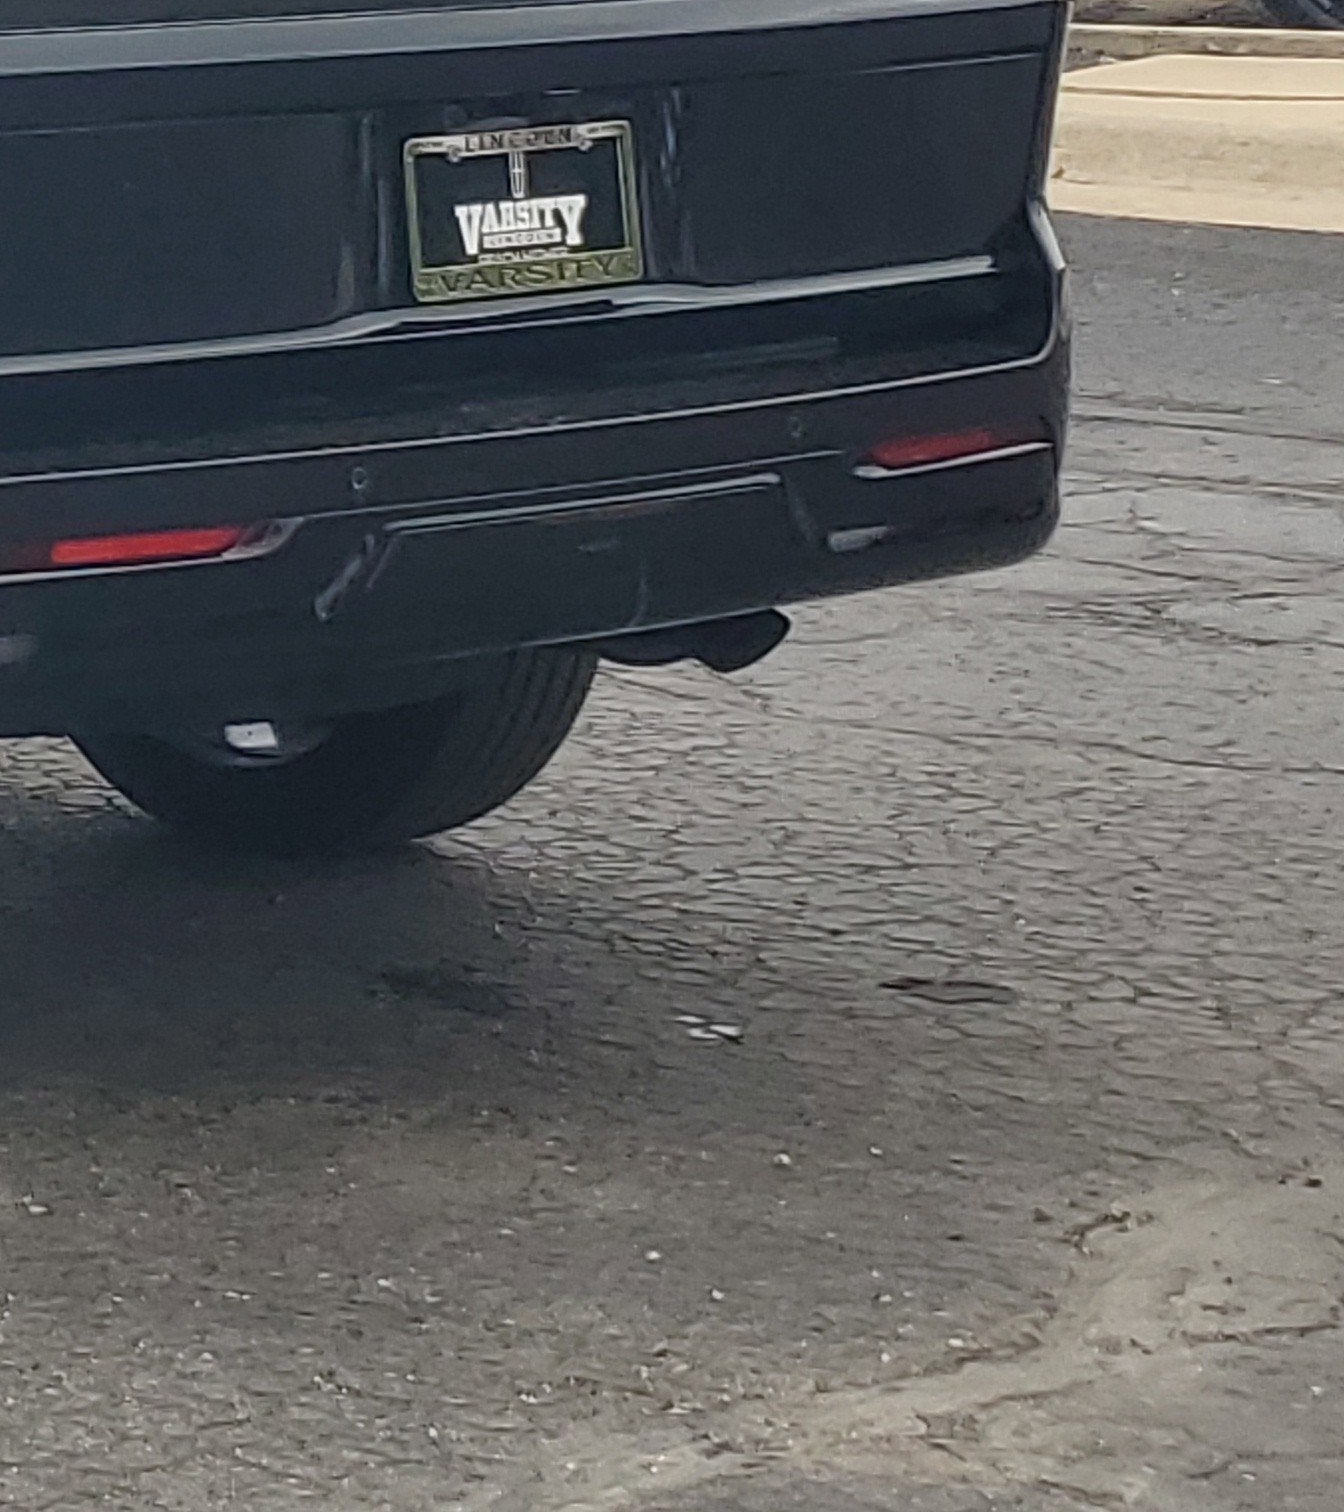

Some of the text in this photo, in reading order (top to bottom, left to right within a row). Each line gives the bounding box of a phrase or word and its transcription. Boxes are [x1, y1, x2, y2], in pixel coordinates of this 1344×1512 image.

[464, 127, 572, 153] LINCOLN
[453, 193, 587, 256] VARSITY
[438, 254, 615, 292] VARSITY
